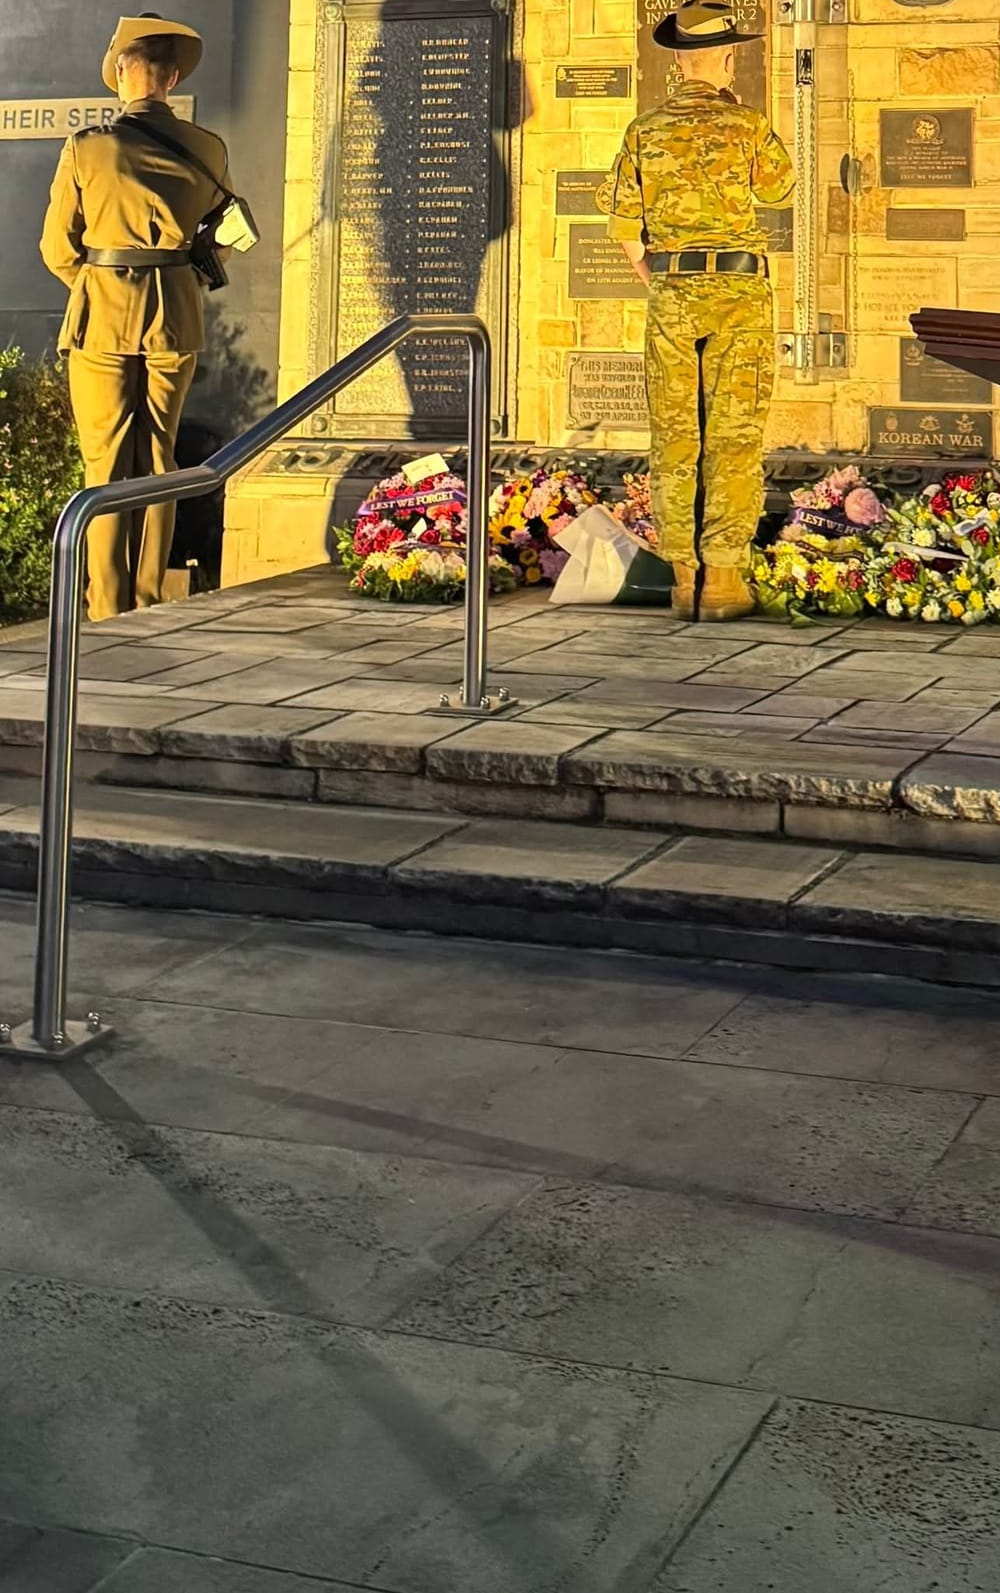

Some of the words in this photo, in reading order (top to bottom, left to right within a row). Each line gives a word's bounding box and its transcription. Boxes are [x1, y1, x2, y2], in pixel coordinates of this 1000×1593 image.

[646, 11, 661, 25] IN
[748, 9, 757, 21] 2
[3, 108, 55, 130] HEIR
[878, 431, 944, 446] KOREAN
[949, 434, 984, 447] WAR
[370, 500, 396, 511] LEST
[396, 496, 415, 508] WE
[415, 490, 455, 506] FORGET
[800, 511, 827, 528] LEST
[826, 519, 843, 532] WE
